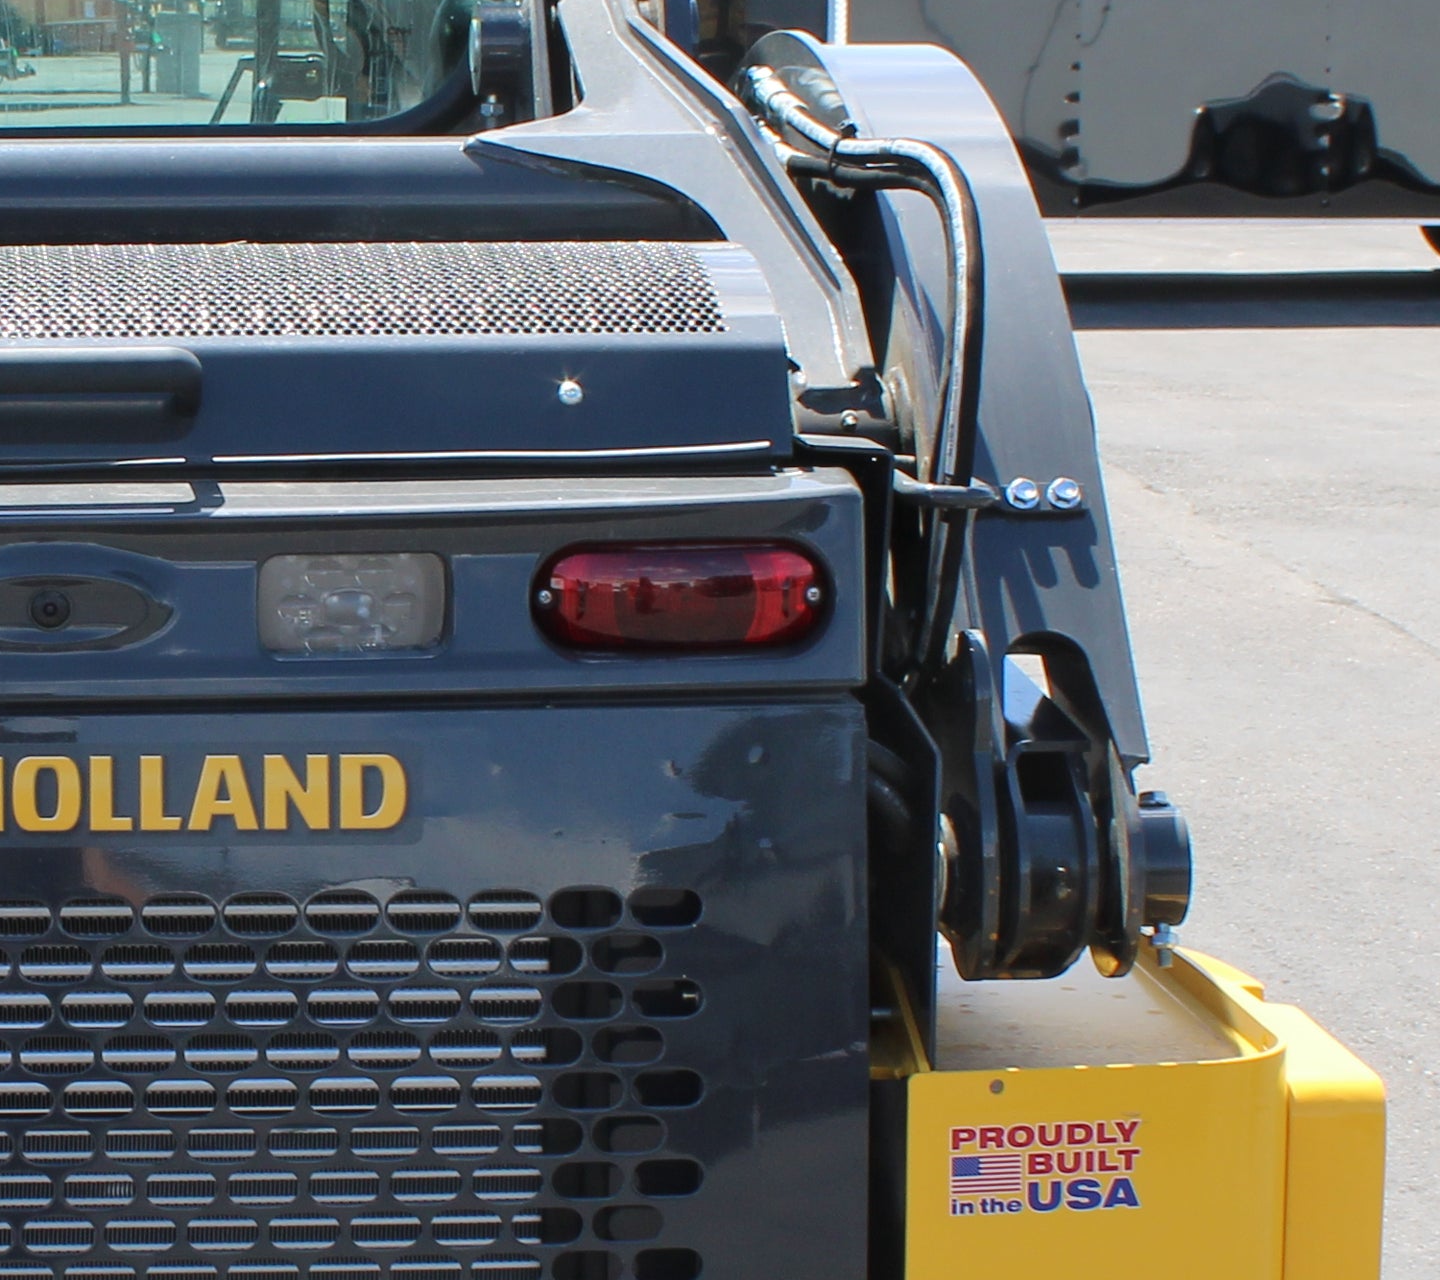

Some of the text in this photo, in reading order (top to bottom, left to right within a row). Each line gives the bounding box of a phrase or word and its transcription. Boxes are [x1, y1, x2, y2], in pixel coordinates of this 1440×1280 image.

[950, 1120, 1140, 1151] PROUDLY
[1027, 1149, 1141, 1175] BUILT
[950, 1177, 1140, 1215] in the USA
